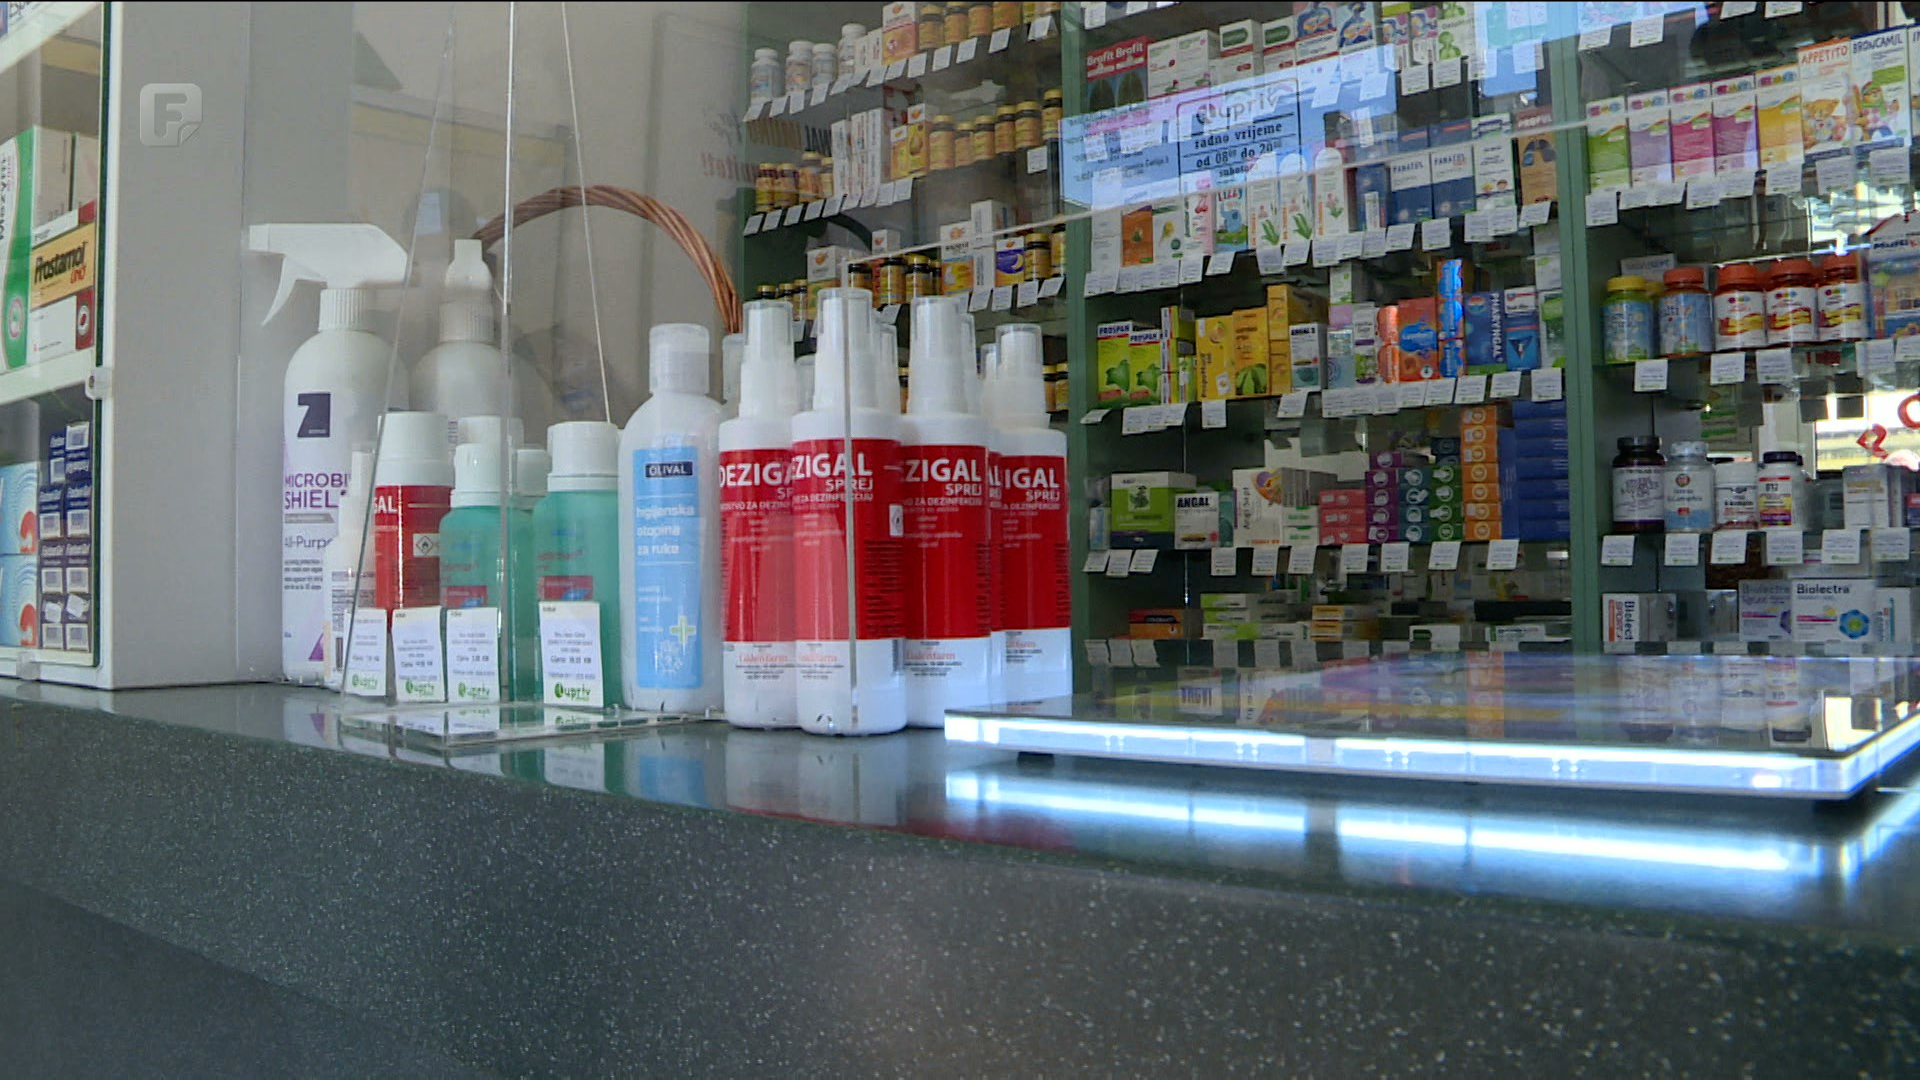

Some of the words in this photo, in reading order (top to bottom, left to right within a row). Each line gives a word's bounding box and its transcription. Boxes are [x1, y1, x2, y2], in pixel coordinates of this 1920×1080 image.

[1116, 42, 1143, 59] Brofit
[1801, 45, 1848, 64] APPETITO
[1235, 122, 1282, 141] vrijeme
[1099, 324, 1130, 336] PROSPAN
[649, 465, 687, 476] OLIVAL
[825, 478, 874, 492] SPREJ
[945, 484, 982, 496] SPREJ
[285, 489, 346, 510] SHIEL
[1797, 582, 1850, 595] Biolectra
